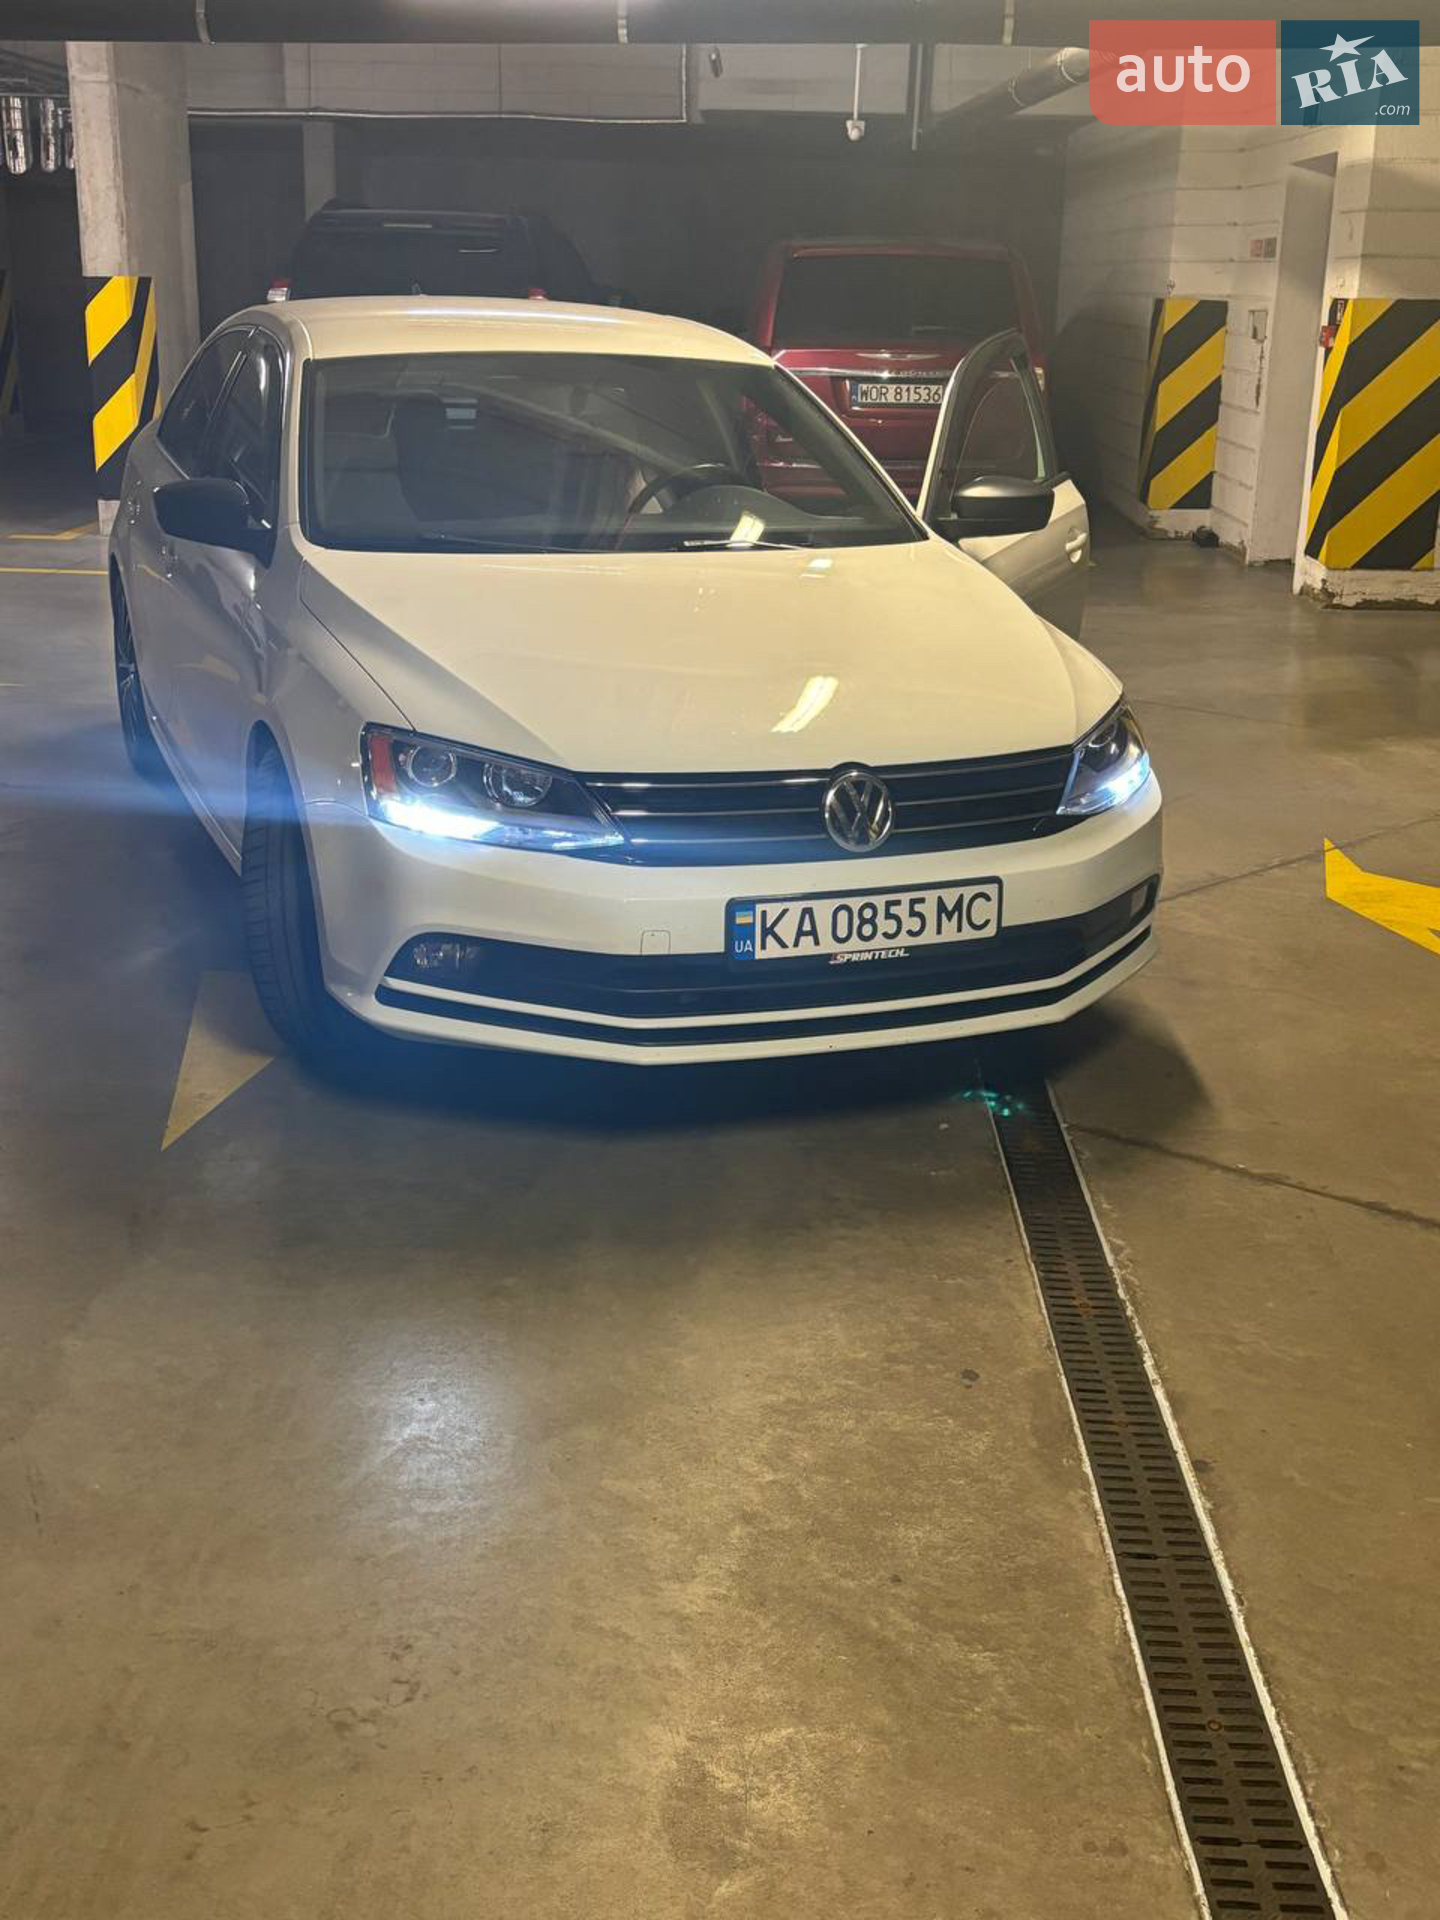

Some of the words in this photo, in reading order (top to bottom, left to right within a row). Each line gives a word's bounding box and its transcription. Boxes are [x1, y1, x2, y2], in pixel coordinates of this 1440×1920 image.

[860, 386, 888, 401] WOR
[893, 386, 941, 402] 81536
[760, 907, 820, 950] KA
[831, 898, 926, 944] 0855
[936, 892, 992, 935] MC
[735, 939, 754, 953] UA
